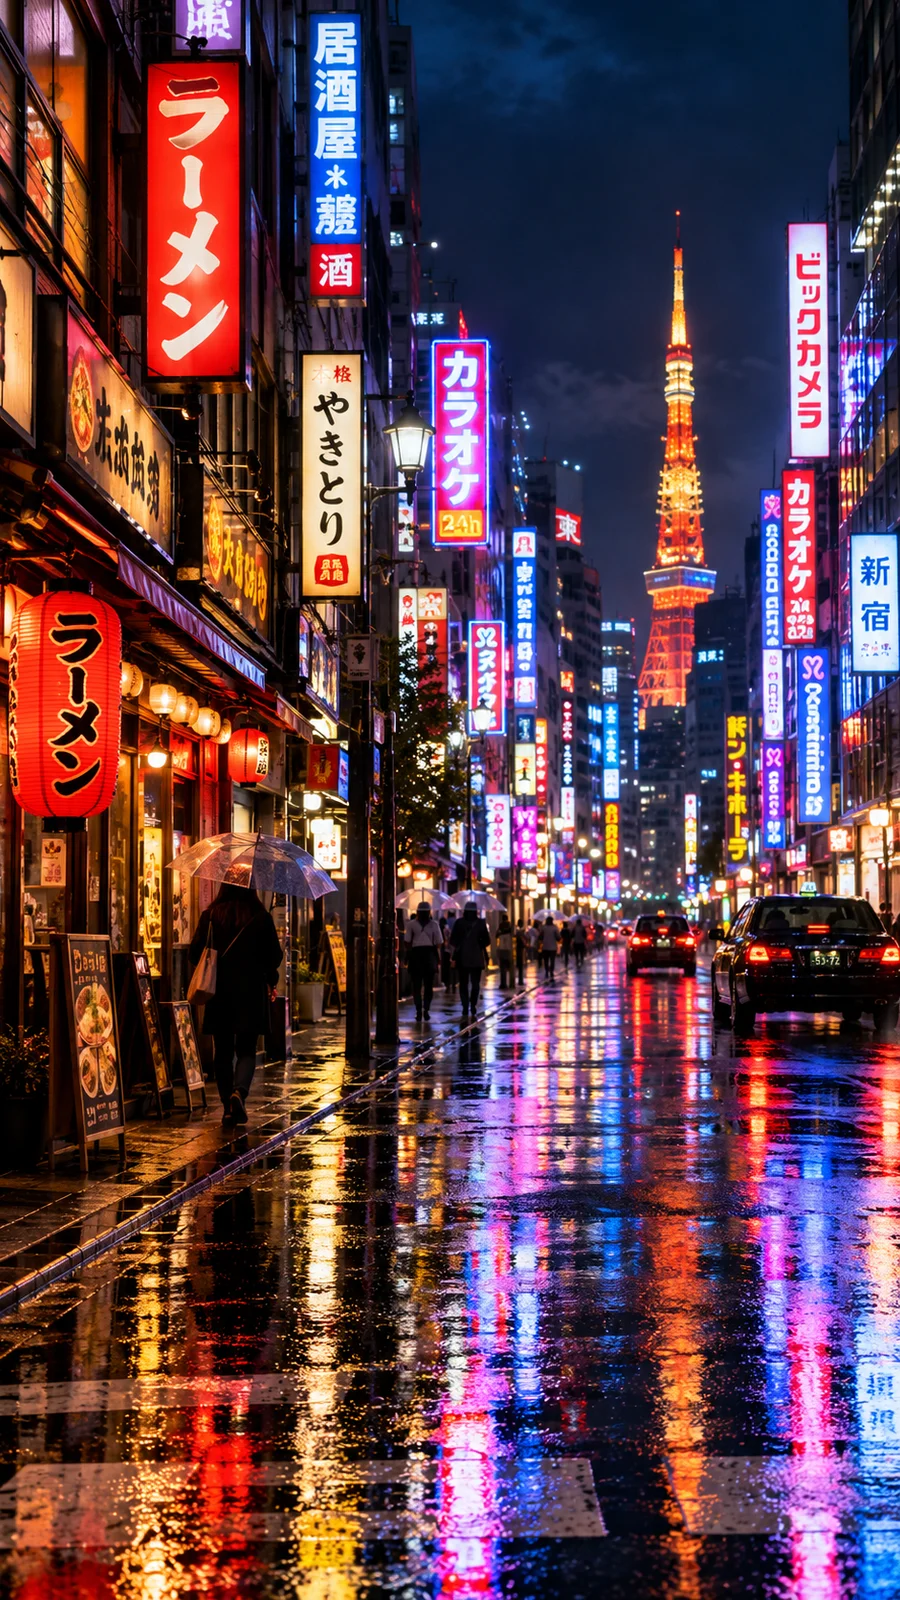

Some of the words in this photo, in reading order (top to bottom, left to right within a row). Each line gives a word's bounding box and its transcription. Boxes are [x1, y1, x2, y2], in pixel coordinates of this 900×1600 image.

[158, 75, 230, 362] ラーメン
[318, 252, 353, 288] 酒
[795, 252, 822, 429] ビックカメラ
[313, 391, 350, 547] やきとり
[442, 350, 480, 506] カラオケ
[441, 514, 481, 534] 24h
[556, 514, 582, 544] 東
[787, 478, 812, 594] カラオケ
[860, 555, 891, 632] 新宿
[47, 609, 103, 797] ラーメン
